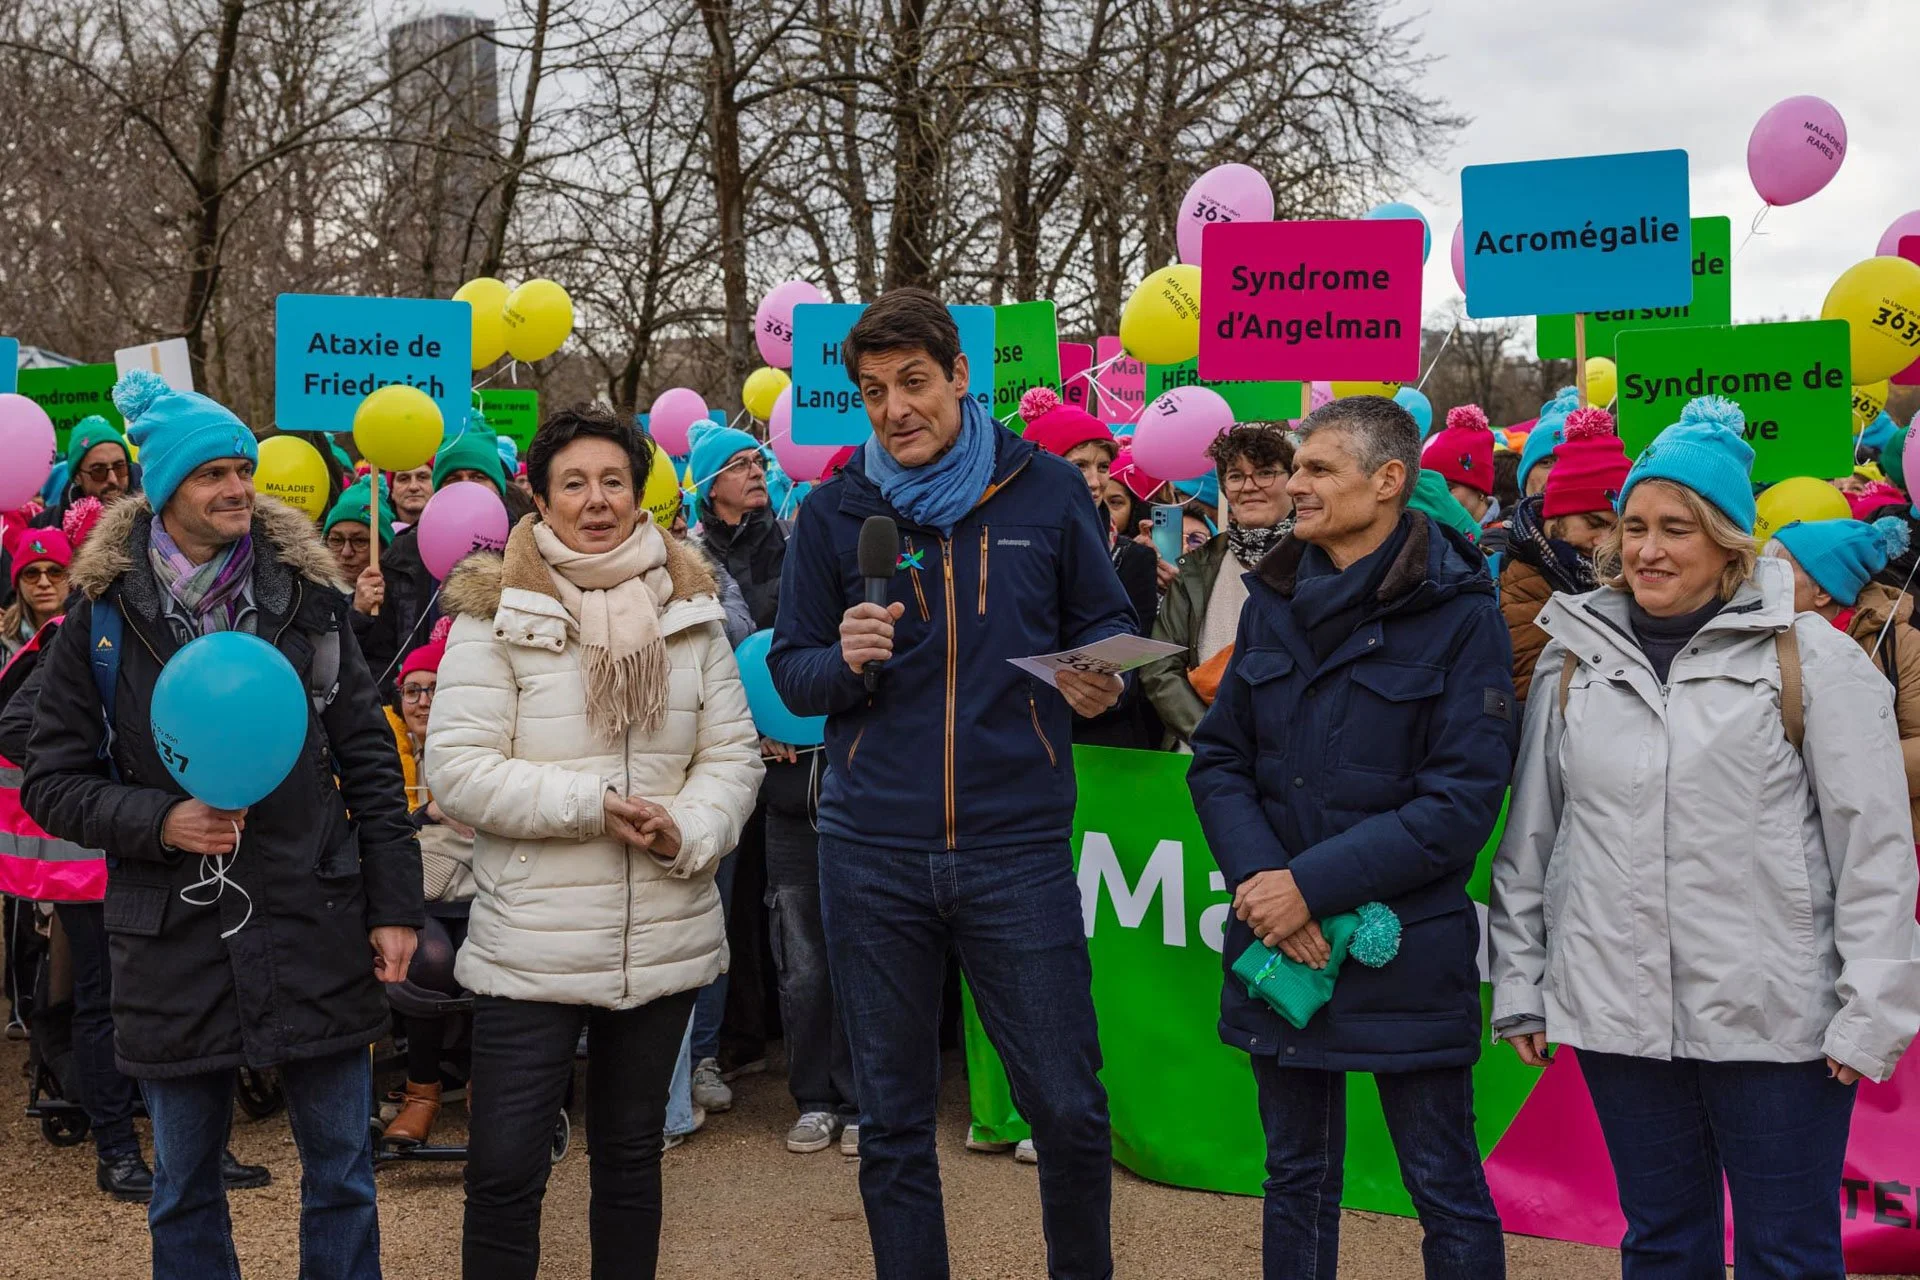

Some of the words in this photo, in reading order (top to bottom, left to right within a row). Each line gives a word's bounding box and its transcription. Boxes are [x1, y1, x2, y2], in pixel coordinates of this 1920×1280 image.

[1804, 121, 1843, 155] MALADIES
[1806, 135, 1834, 160] RARES
[1475, 216, 1680, 255] Acromégalie
[1232, 263, 1390, 296] Syndrome
[1692, 252, 1724, 275] de
[1162, 290, 1188, 320] RARES
[1166, 278, 1200, 320] MALADIES
[1217, 311, 1401, 345] d'Angelman
[308, 333, 399, 356] Ataxie
[408, 334, 441, 358] de
[1625, 369, 1792, 404] Syndrome
[1803, 361, 1843, 390] de
[265, 482, 315, 493] MALADIES
[281, 496, 307, 504] ARES
[155, 737, 189, 774] 37
